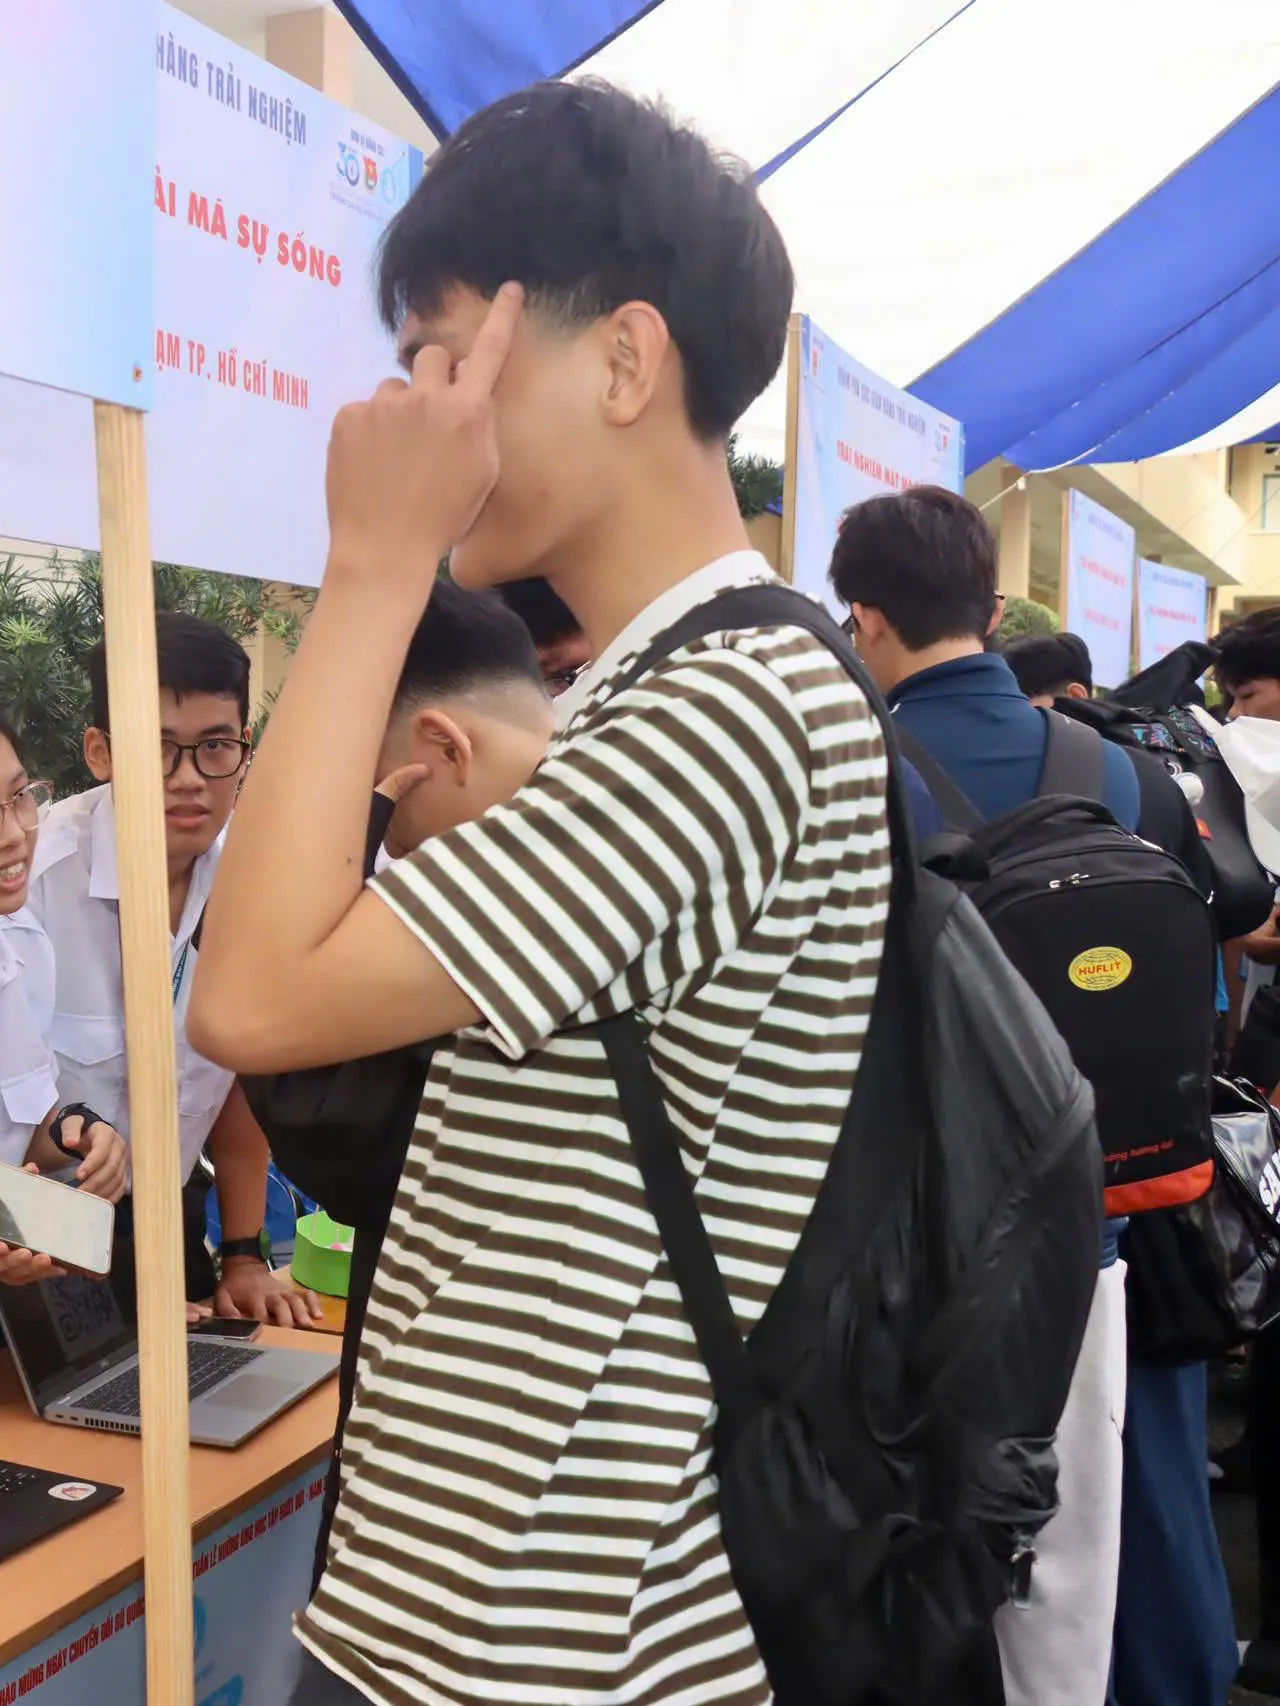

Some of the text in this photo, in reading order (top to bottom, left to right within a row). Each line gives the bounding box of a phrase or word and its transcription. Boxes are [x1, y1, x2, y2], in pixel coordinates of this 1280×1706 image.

[156, 31, 199, 89] HÀNG
[206, 61, 241, 112] TRẢI
[248, 85, 306, 147] NGHIỆM
[237, 214, 270, 264] SỰ
[277, 231, 342, 287] SỐNG
[187, 339, 211, 380] TP.
[218, 346, 238, 387] HỒ
[243, 359, 267, 397] CHÍ
[273, 368, 308, 410] MINH
[1078, 961, 1122, 976] HUFLIT
